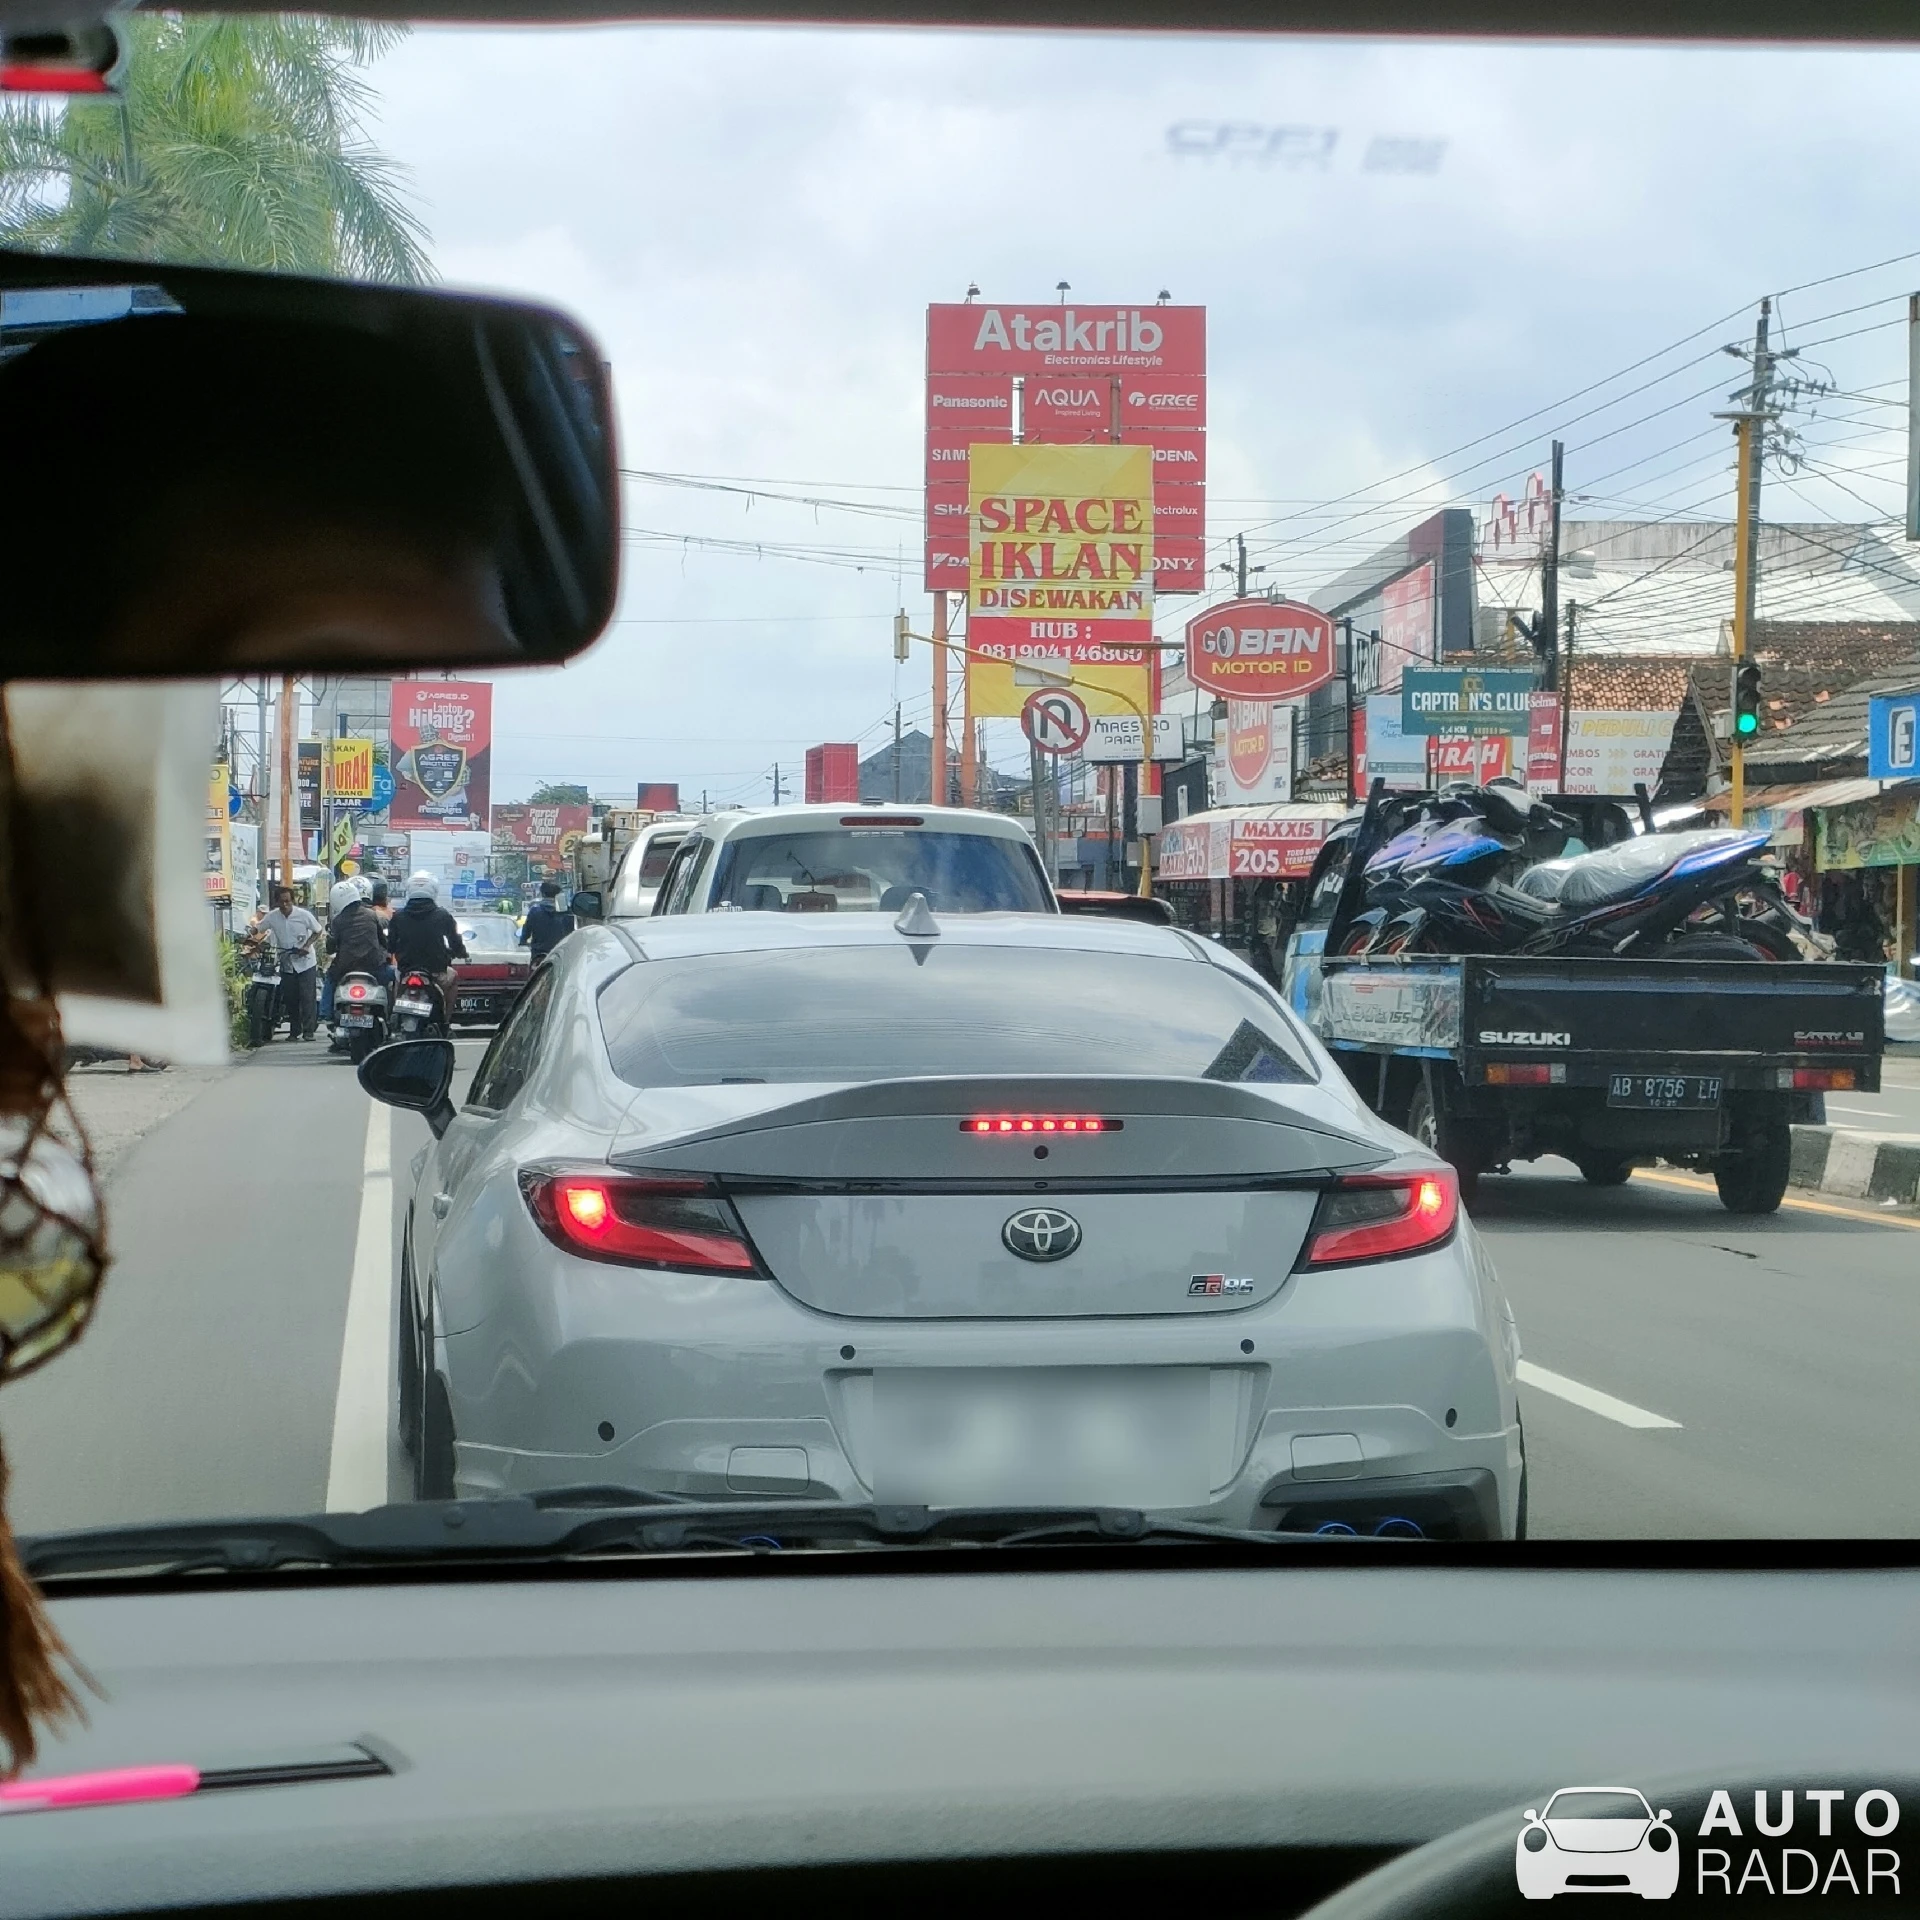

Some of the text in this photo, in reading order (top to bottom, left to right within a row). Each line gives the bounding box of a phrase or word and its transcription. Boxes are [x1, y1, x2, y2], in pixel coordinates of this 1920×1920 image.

[974, 310, 1164, 352] Atakrib
[1044, 354, 1163, 368] Electronics Lifestyle
[932, 395, 1008, 409] Panasonic
[1034, 389, 1100, 407] AQUA
[1148, 393, 1199, 407] GREE
[1081, 408, 1101, 418] Living
[932, 448, 971, 461] SAM
[979, 498, 1143, 535] SPACE
[979, 542, 1144, 581] IKLAN
[979, 588, 1143, 610] DISEWAKAN
[1030, 622, 1078, 640] HUB
[1239, 626, 1322, 655] BAN
[1212, 660, 1313, 674] MOTOR ID
[433, 702, 463, 715] Laptop
[408, 708, 475, 734] Hilang?
[1094, 718, 1170, 734] MAESRO
[1454, 725, 1468, 734] KM
[419, 753, 460, 761] AGRES
[1242, 821, 1315, 838] MAXXIS
[1234, 849, 1280, 874] 205
[1479, 1031, 1571, 1046] SUZUKI
[1612, 1077, 1632, 1097] AB
[1645, 1078, 1686, 1098] 8756
[1191, 1282, 1221, 1293] GR
